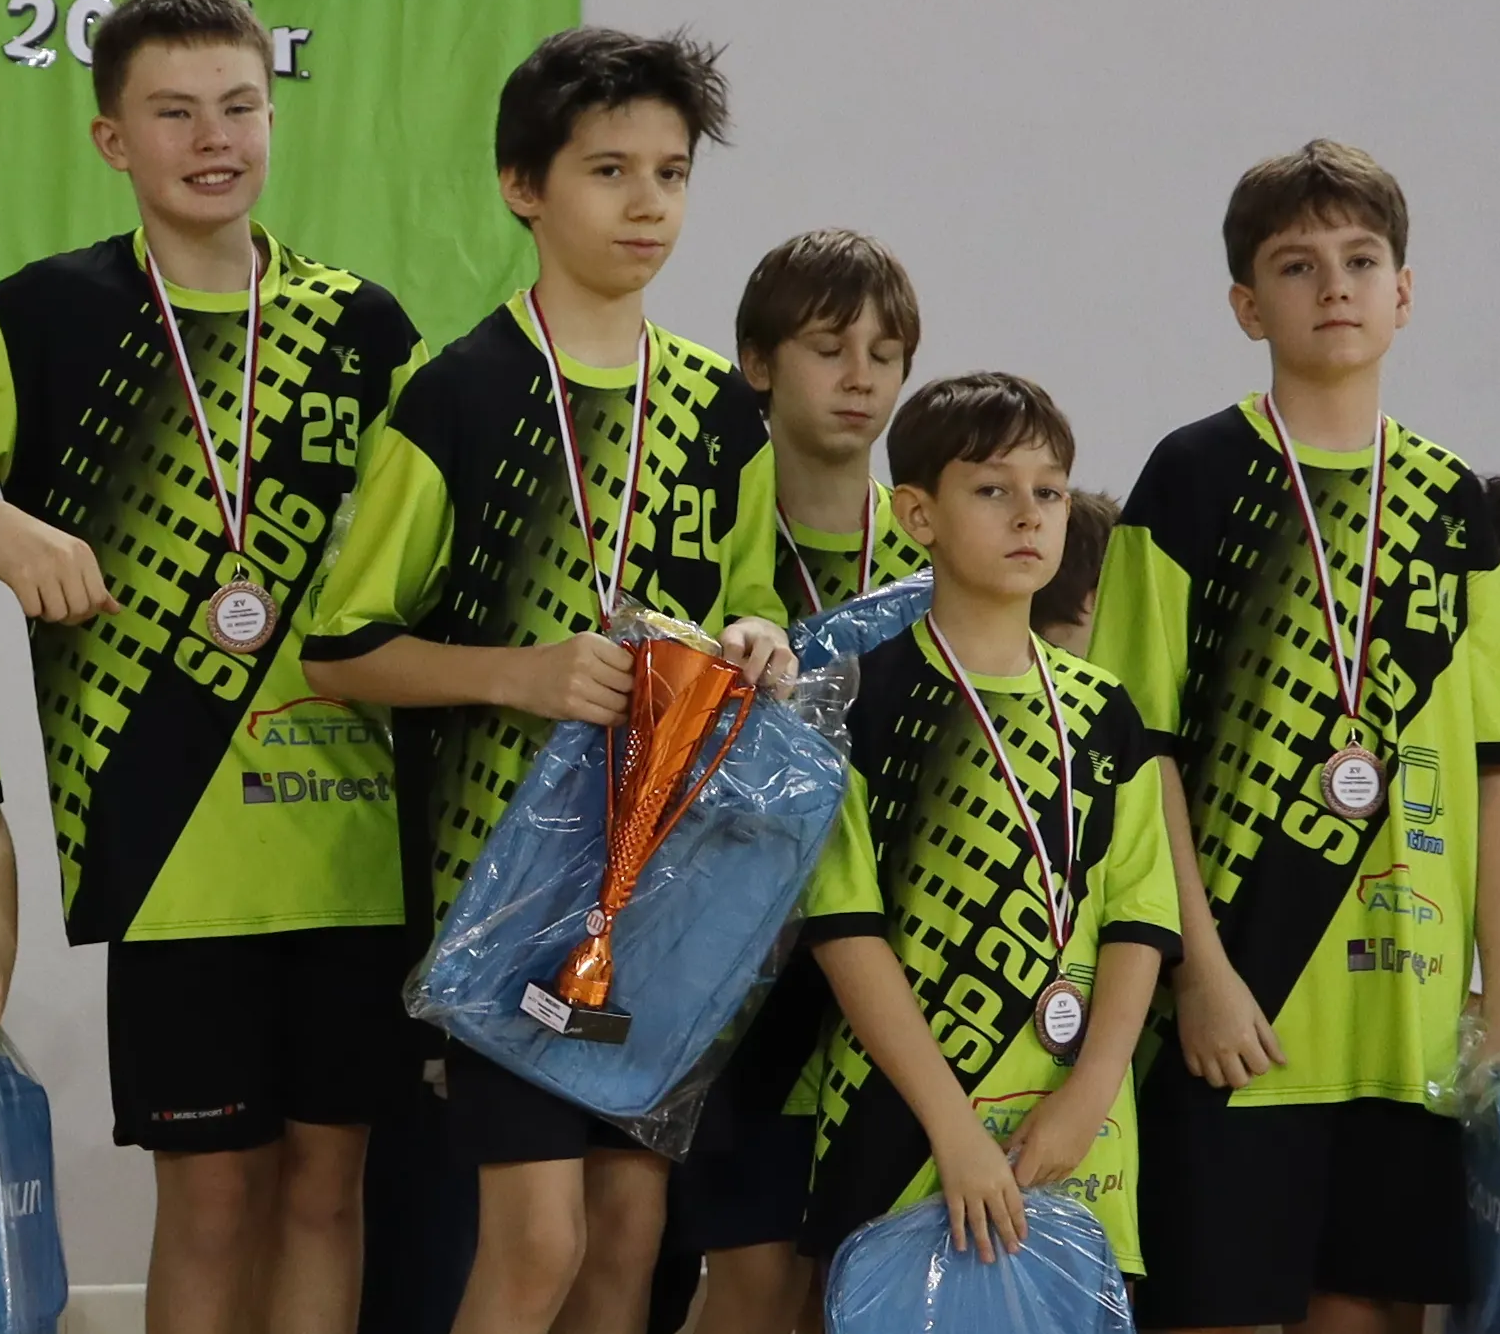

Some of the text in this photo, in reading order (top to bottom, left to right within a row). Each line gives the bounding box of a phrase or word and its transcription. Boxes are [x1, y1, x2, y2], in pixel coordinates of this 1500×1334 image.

[300, 391, 361, 467] 23
[276, 767, 391, 804] Direct
[930, 973, 1004, 1074] SP
